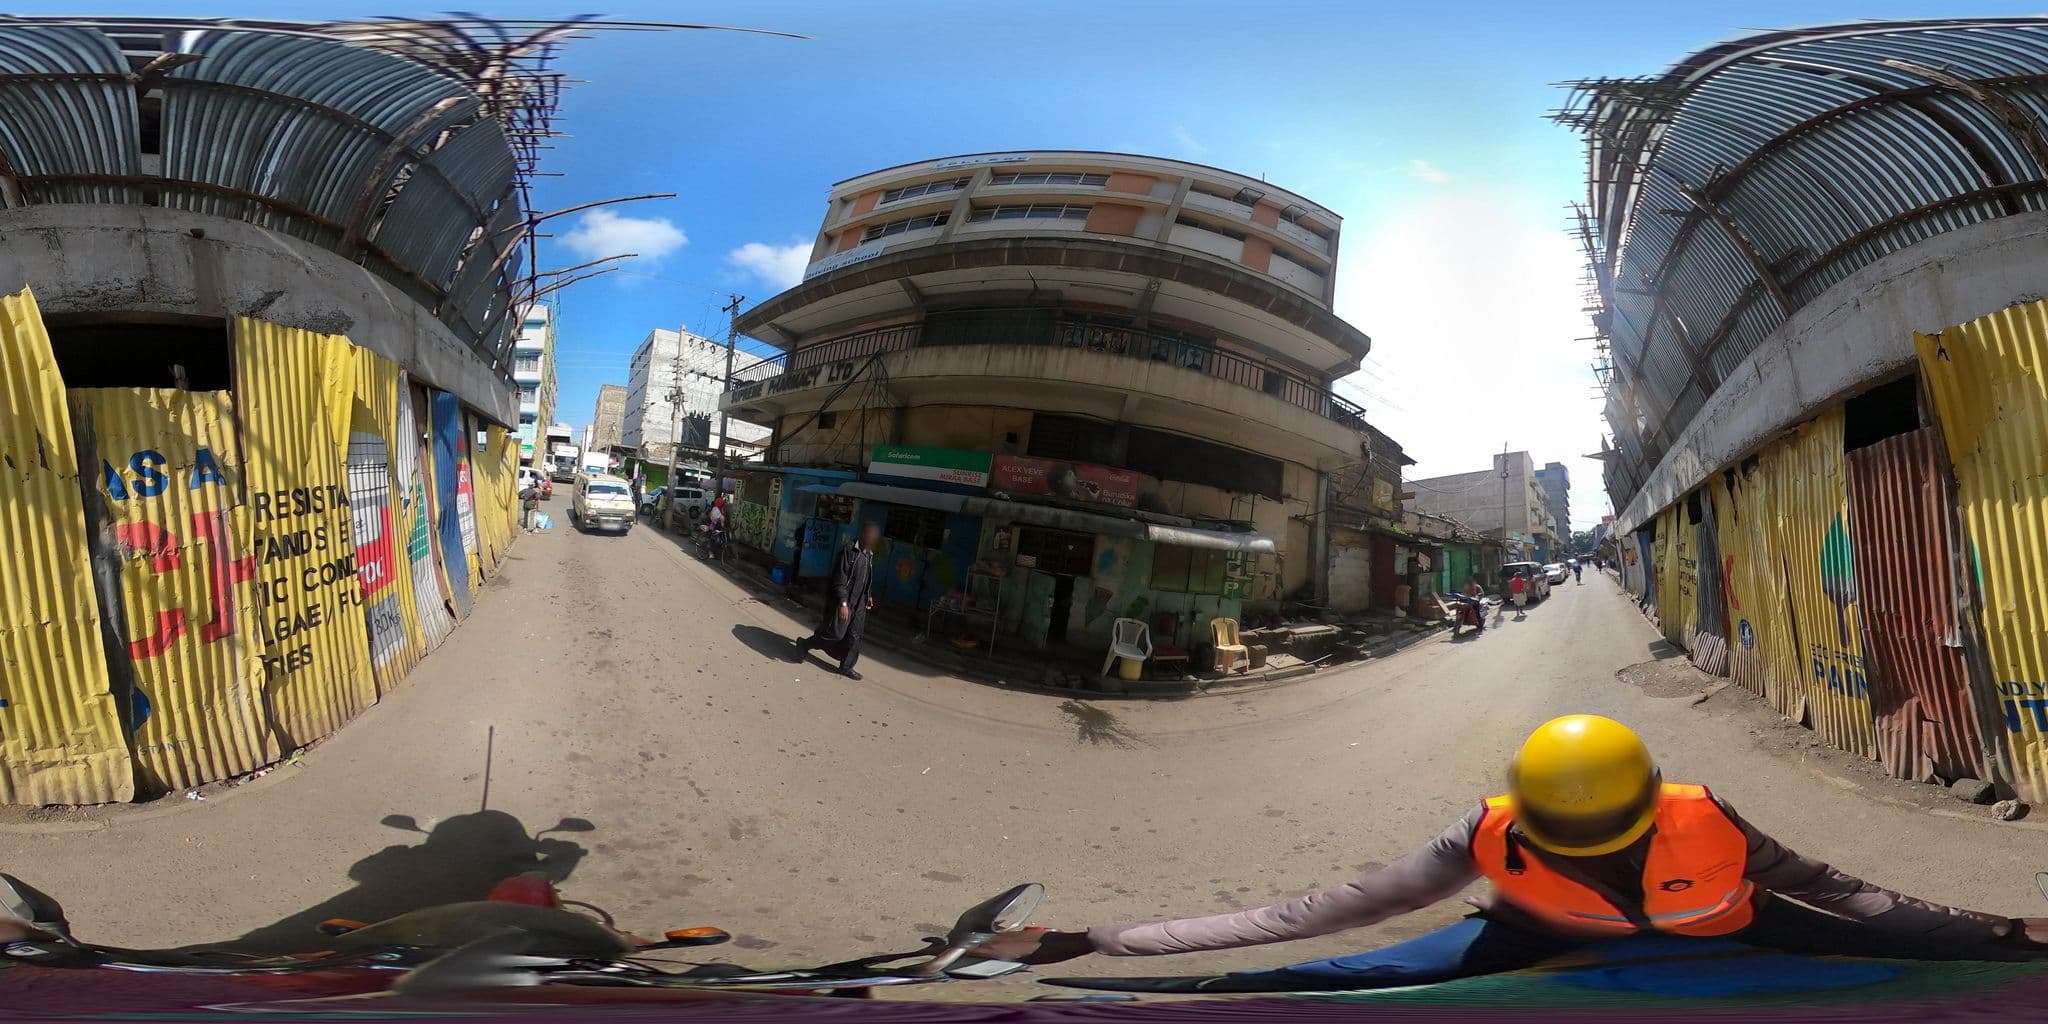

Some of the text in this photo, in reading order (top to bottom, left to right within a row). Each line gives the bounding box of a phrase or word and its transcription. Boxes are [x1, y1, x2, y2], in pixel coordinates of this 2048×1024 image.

[827, 361, 854, 382] LTD
[888, 451, 920, 460] Safaricom
[1002, 464, 1021, 474] ALEX
[1011, 473, 1033, 484] BASE
[255, 485, 350, 522] RESISTA
